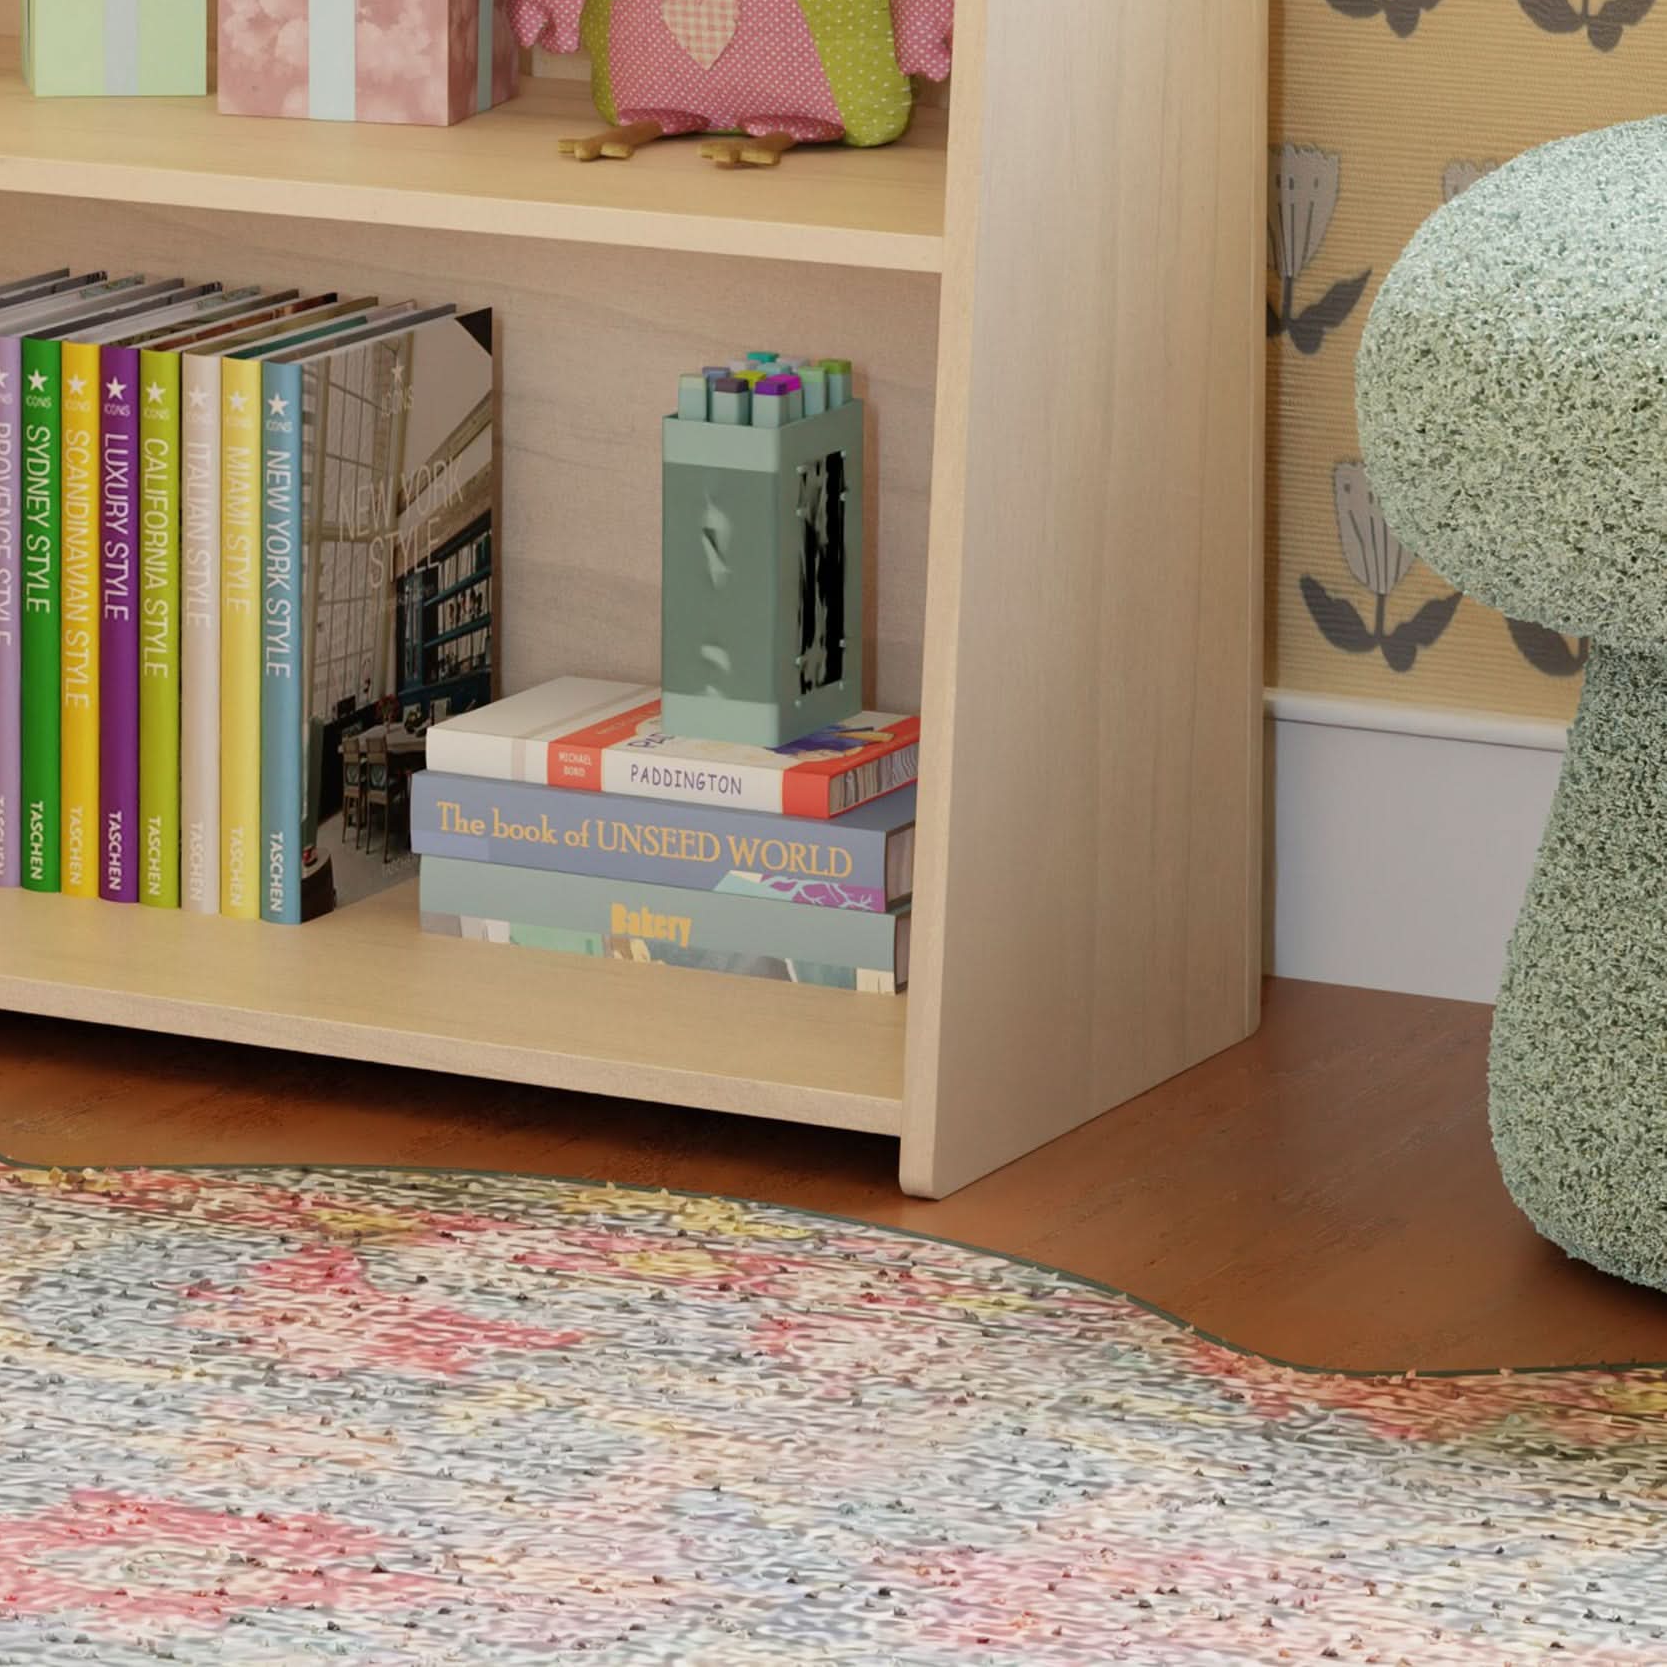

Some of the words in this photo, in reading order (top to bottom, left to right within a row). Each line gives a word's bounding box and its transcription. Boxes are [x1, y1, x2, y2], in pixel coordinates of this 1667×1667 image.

[25, 424, 51, 529] SYDNEY
[103, 433, 130, 535] LUXURY
[143, 436, 169, 592] CALIFORNIA
[185, 441, 212, 542] ITALIAN
[224, 444, 252, 529] MIAMI
[265, 449, 292, 513] NEW
[338, 477, 395, 544] NEW
[400, 455, 464, 520] YORK
[65, 429, 91, 623] SCANDINAVIAN
[265, 518, 292, 592] YORK
[369, 516, 441, 589] STYLE
[25, 534, 51, 615] STYLE
[103, 540, 130, 622] STYLE
[185, 548, 212, 629] STYLE
[224, 534, 252, 616] STYLE
[65, 629, 91, 710] STYLE
[143, 597, 169, 679] STYLE
[265, 597, 292, 680] STYLE
[630, 763, 743, 796] PADDINGTON
[29, 800, 44, 881] TASCHEN
[69, 805, 84, 886] TASCHEN
[108, 810, 123, 892] TASCHEN
[147, 816, 162, 897] TASCHEN
[189, 821, 204, 903] TASCHEN
[229, 826, 245, 909] TASCHEN
[269, 831, 284, 913] TASCHEN
[436, 801, 486, 836] The
[492, 807, 558, 847] book
[564, 819, 592, 849] of
[596, 820, 721, 863] UNSEED
[728, 834, 854, 879] WORLD
[611, 902, 693, 948] Bakery
